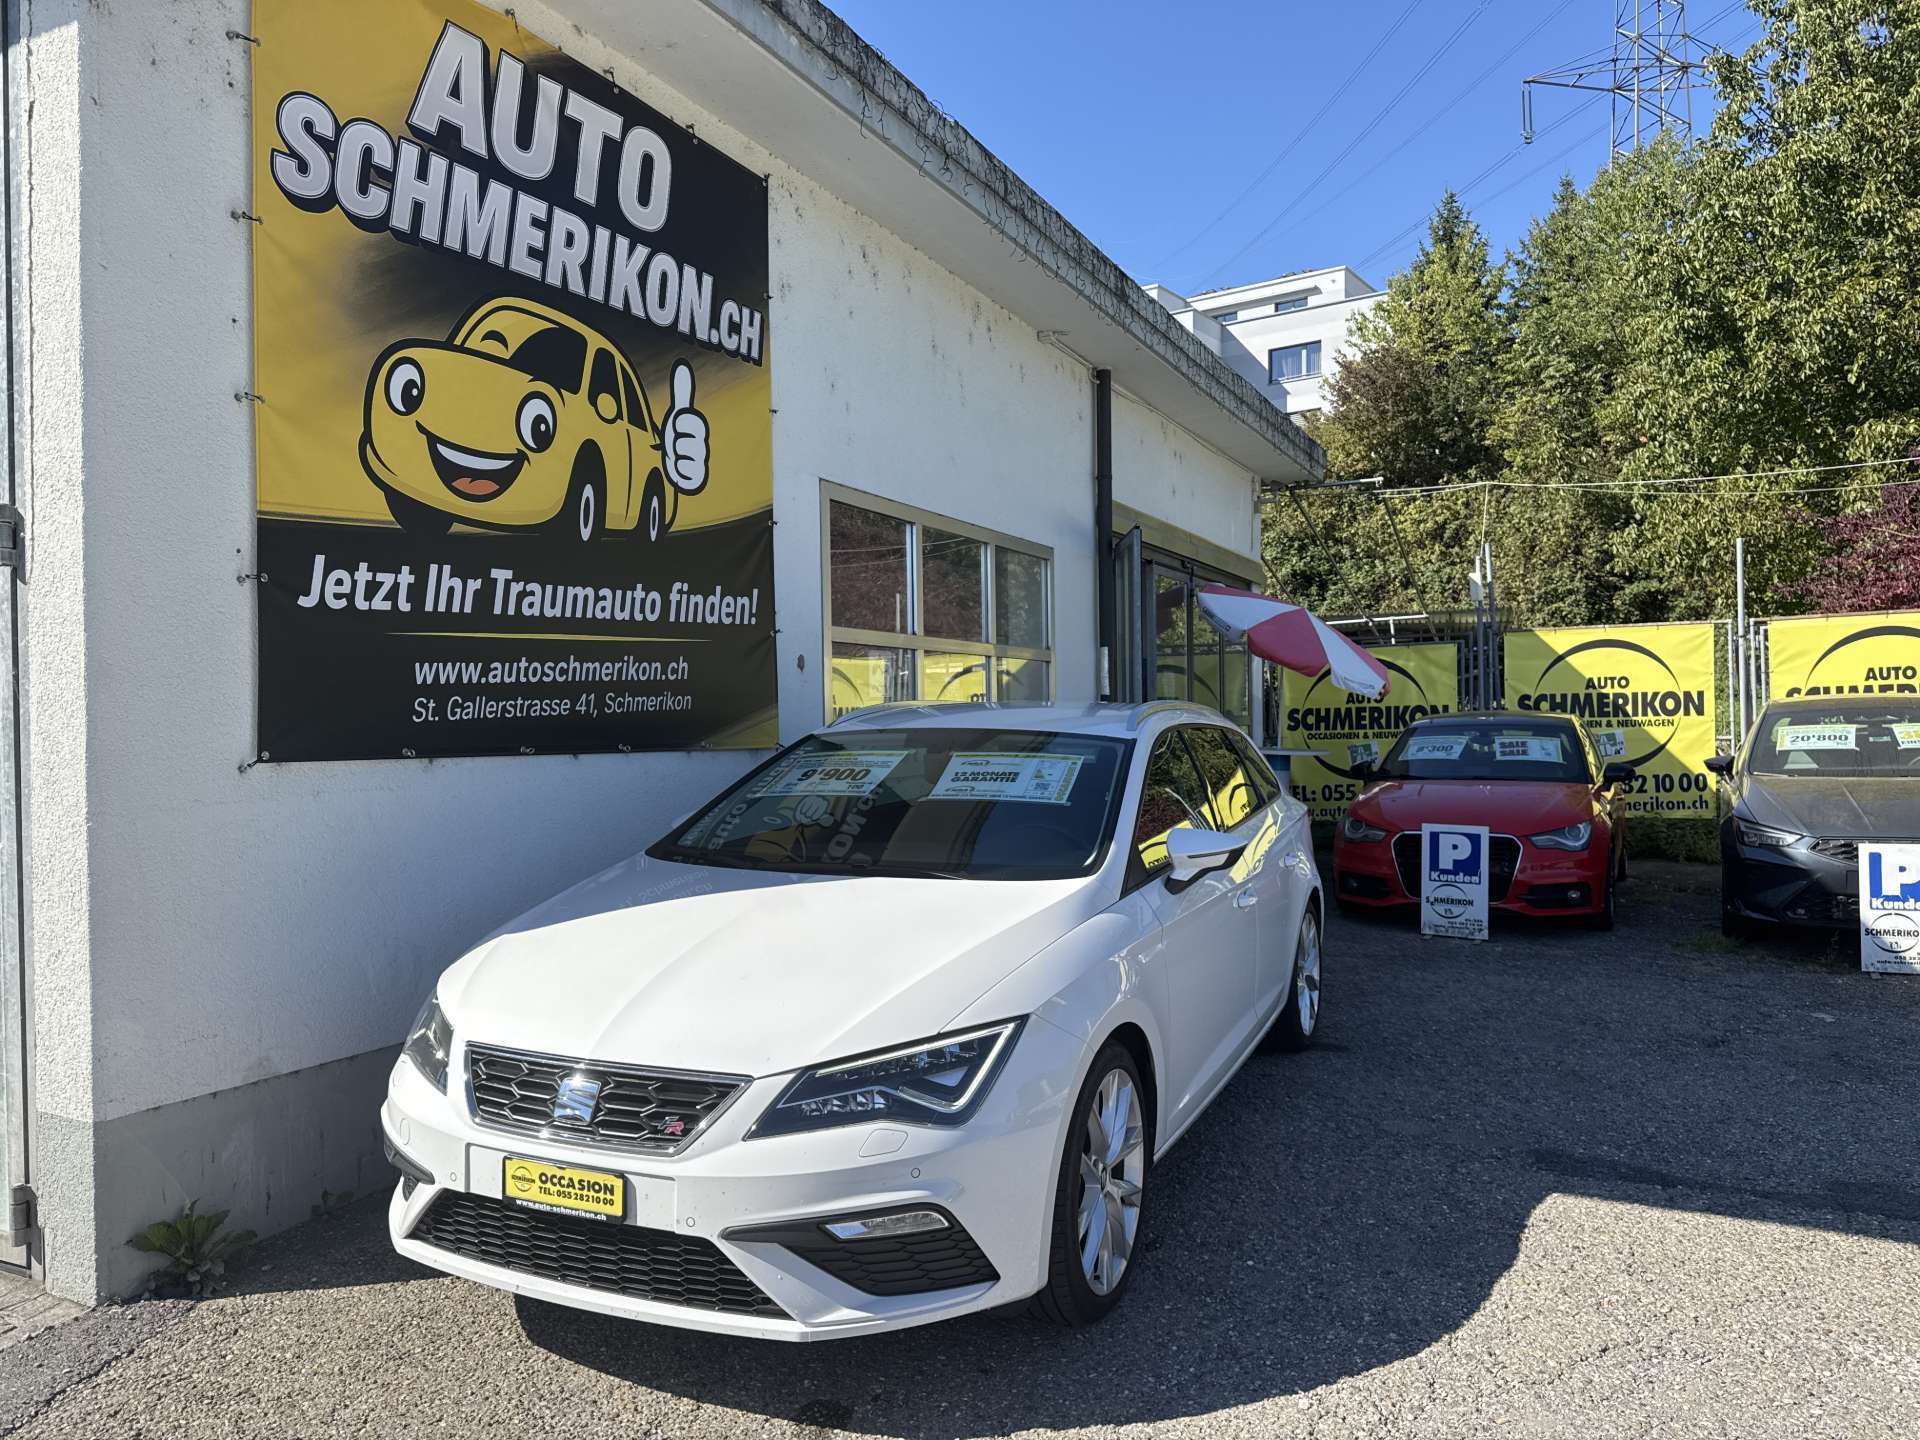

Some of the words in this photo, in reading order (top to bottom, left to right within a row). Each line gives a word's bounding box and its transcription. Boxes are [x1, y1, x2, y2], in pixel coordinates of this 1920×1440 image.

[407, 20, 673, 233] AUTO
[273, 92, 763, 363] SCHMERIKON.CH
[296, 554, 416, 612] Jetzt
[424, 563, 482, 614] Ihr
[490, 568, 662, 622] Traumauto
[668, 581, 759, 625] finden!
[414, 654, 690, 685] www.autoschmerikon.ch
[1865, 665, 1918, 682] AUTO
[1585, 675, 1631, 691] AUTO
[412, 697, 440, 722] St.
[446, 694, 571, 722] Gallerstrasse
[574, 692, 599, 719] 41,
[603, 691, 692, 714] Schmerikon
[1517, 690, 1705, 718] SCHMERIKON
[1605, 719, 1613, 728] &
[1617, 718, 1675, 728] NEUWAGEN
[1307, 731, 1360, 741] OCCASIONEN
[1362, 731, 1370, 740] &
[1372, 731, 1402, 740] NEUW
[1790, 733, 1849, 743] 20'800
[798, 768, 872, 782] 9'900
[1321, 784, 1357, 802] 055
[1438, 833, 1472, 870] P
[1430, 871, 1480, 884] Kunden
[538, 1172, 615, 1197] OCCASION
[538, 1186, 556, 1197] TEL:
[556, 1191, 573, 1200] 055
